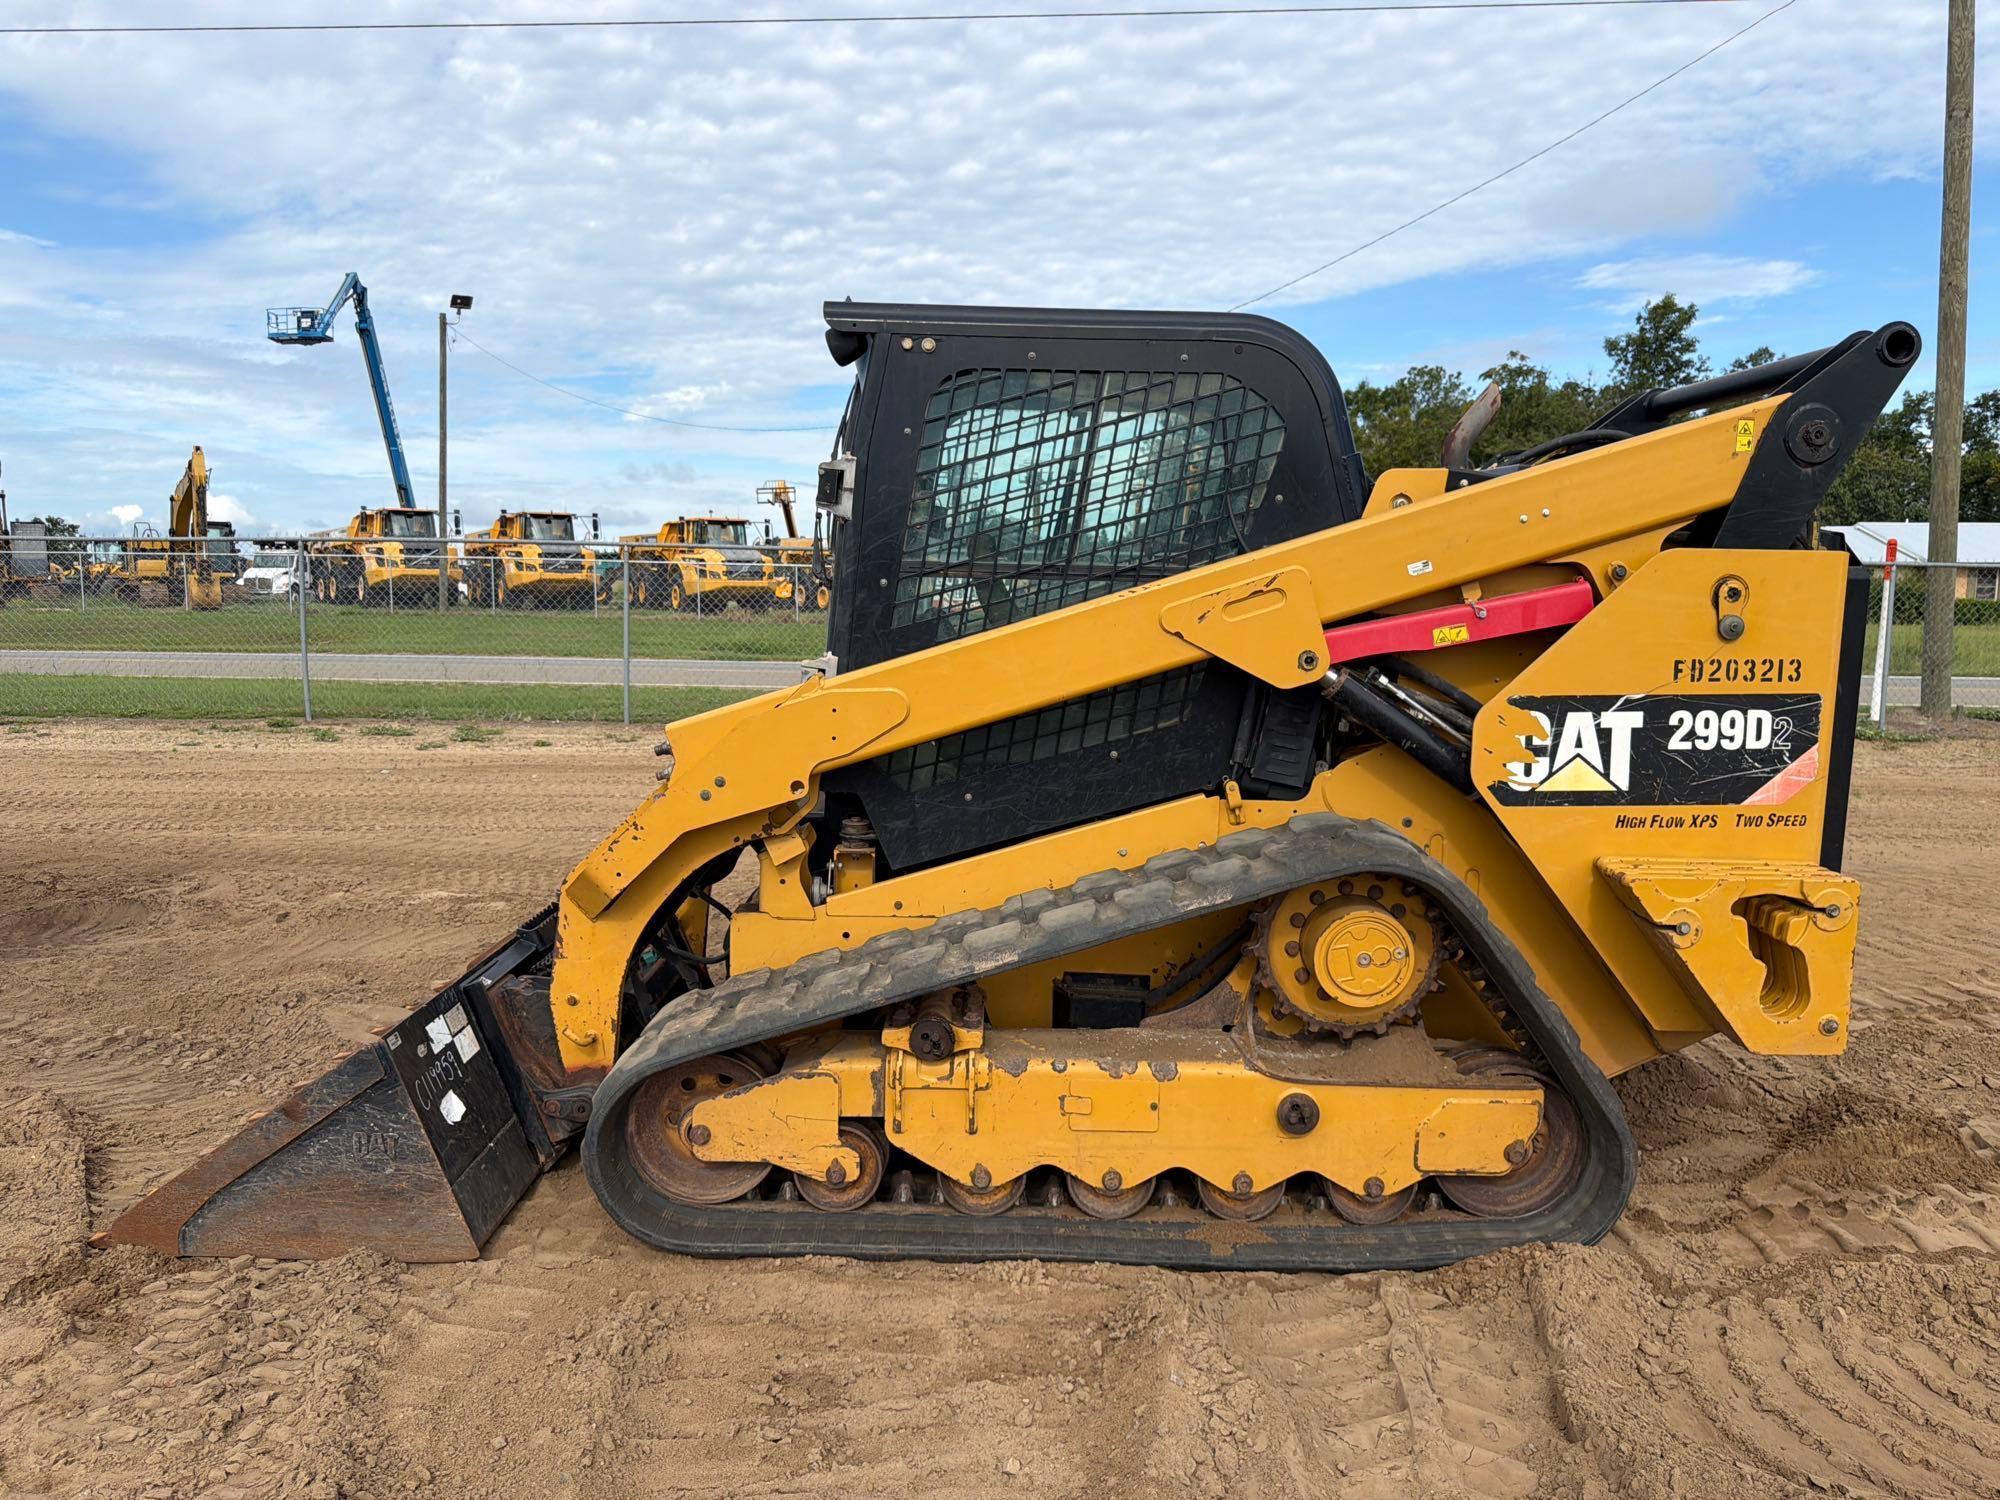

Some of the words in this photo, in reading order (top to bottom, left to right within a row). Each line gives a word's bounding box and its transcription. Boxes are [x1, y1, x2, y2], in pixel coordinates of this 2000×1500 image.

[1673, 658, 1802, 683] FD203213
[1615, 814, 1647, 828] HIGH
[1649, 814, 1685, 828] FLOW
[1689, 814, 1719, 828] XPS
[1735, 813, 1763, 828] TWO
[1766, 813, 1807, 828] SPEED
[352, 1131, 400, 1161] CAT
